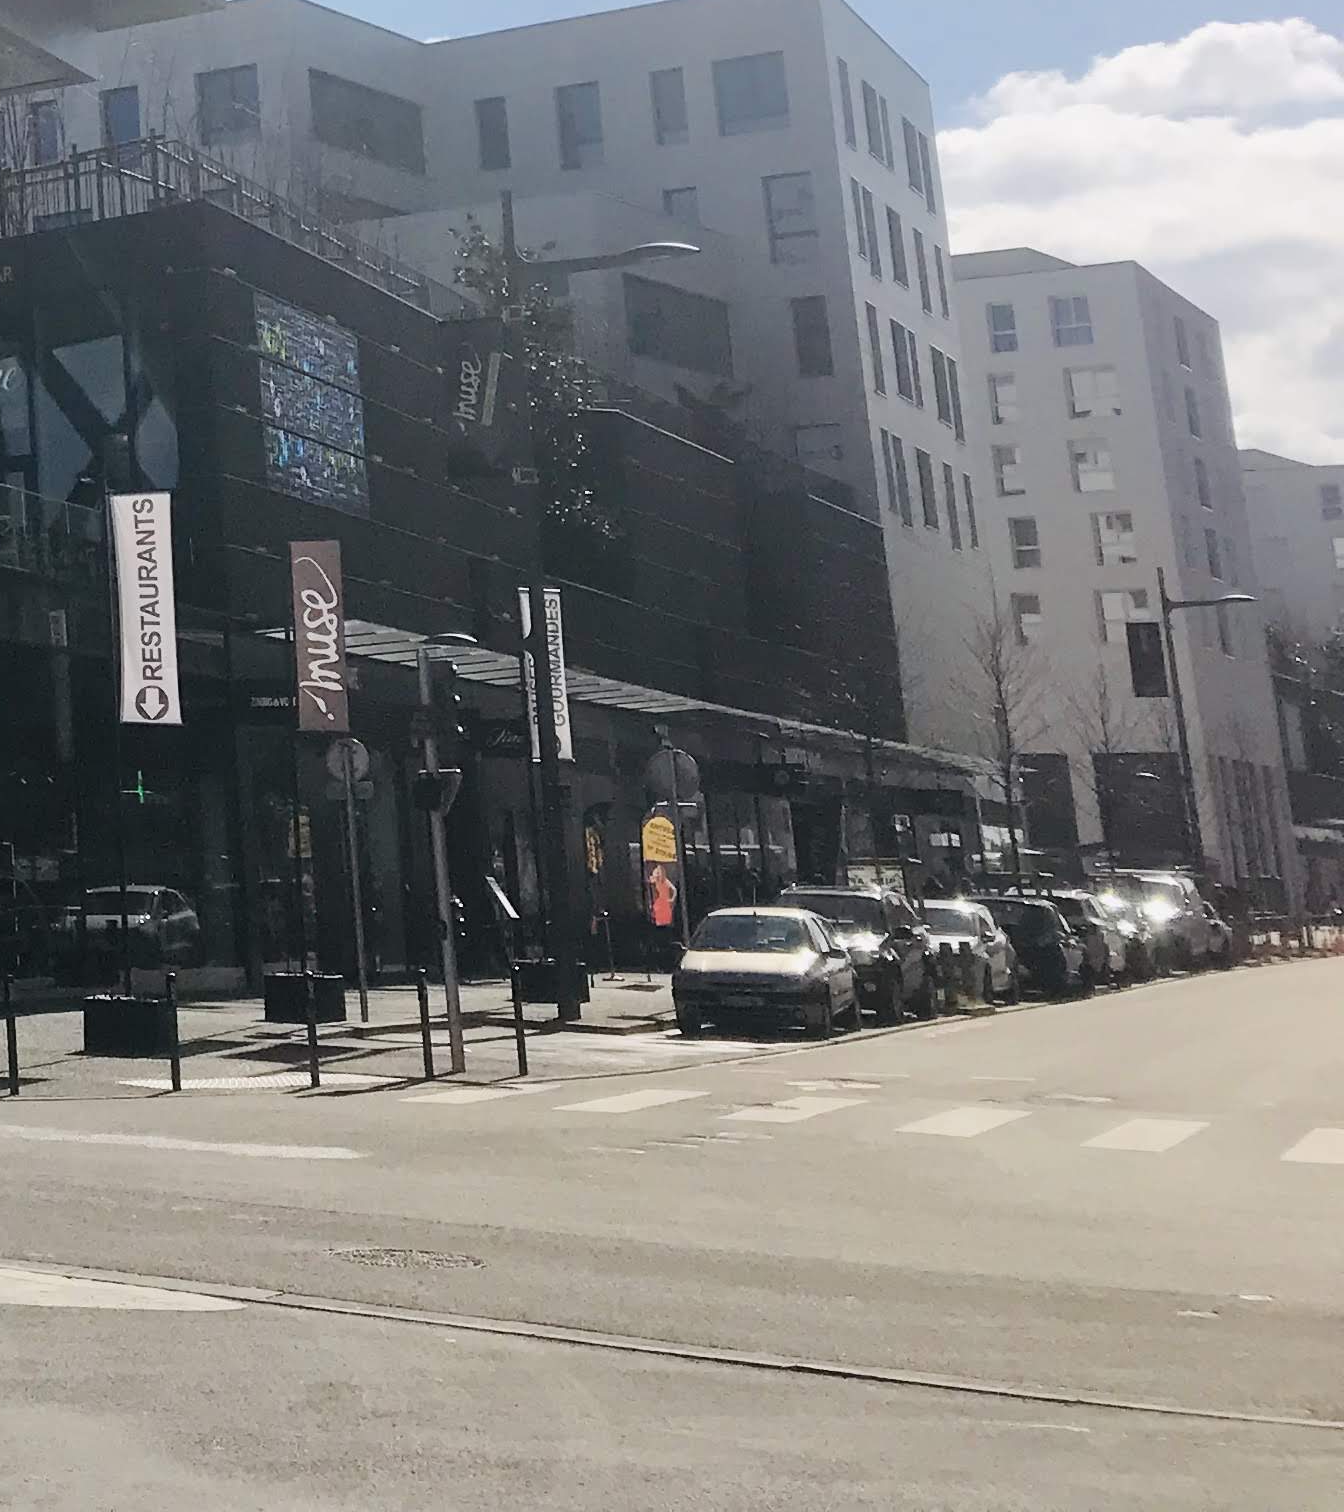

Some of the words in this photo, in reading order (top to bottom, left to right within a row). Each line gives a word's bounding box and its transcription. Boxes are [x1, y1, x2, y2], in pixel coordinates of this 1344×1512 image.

[452, 345, 482, 436] muse
[132, 497, 164, 682] RESTAURANTS
[293, 556, 345, 721] muse
[544, 598, 566, 727] GOURMANDES
